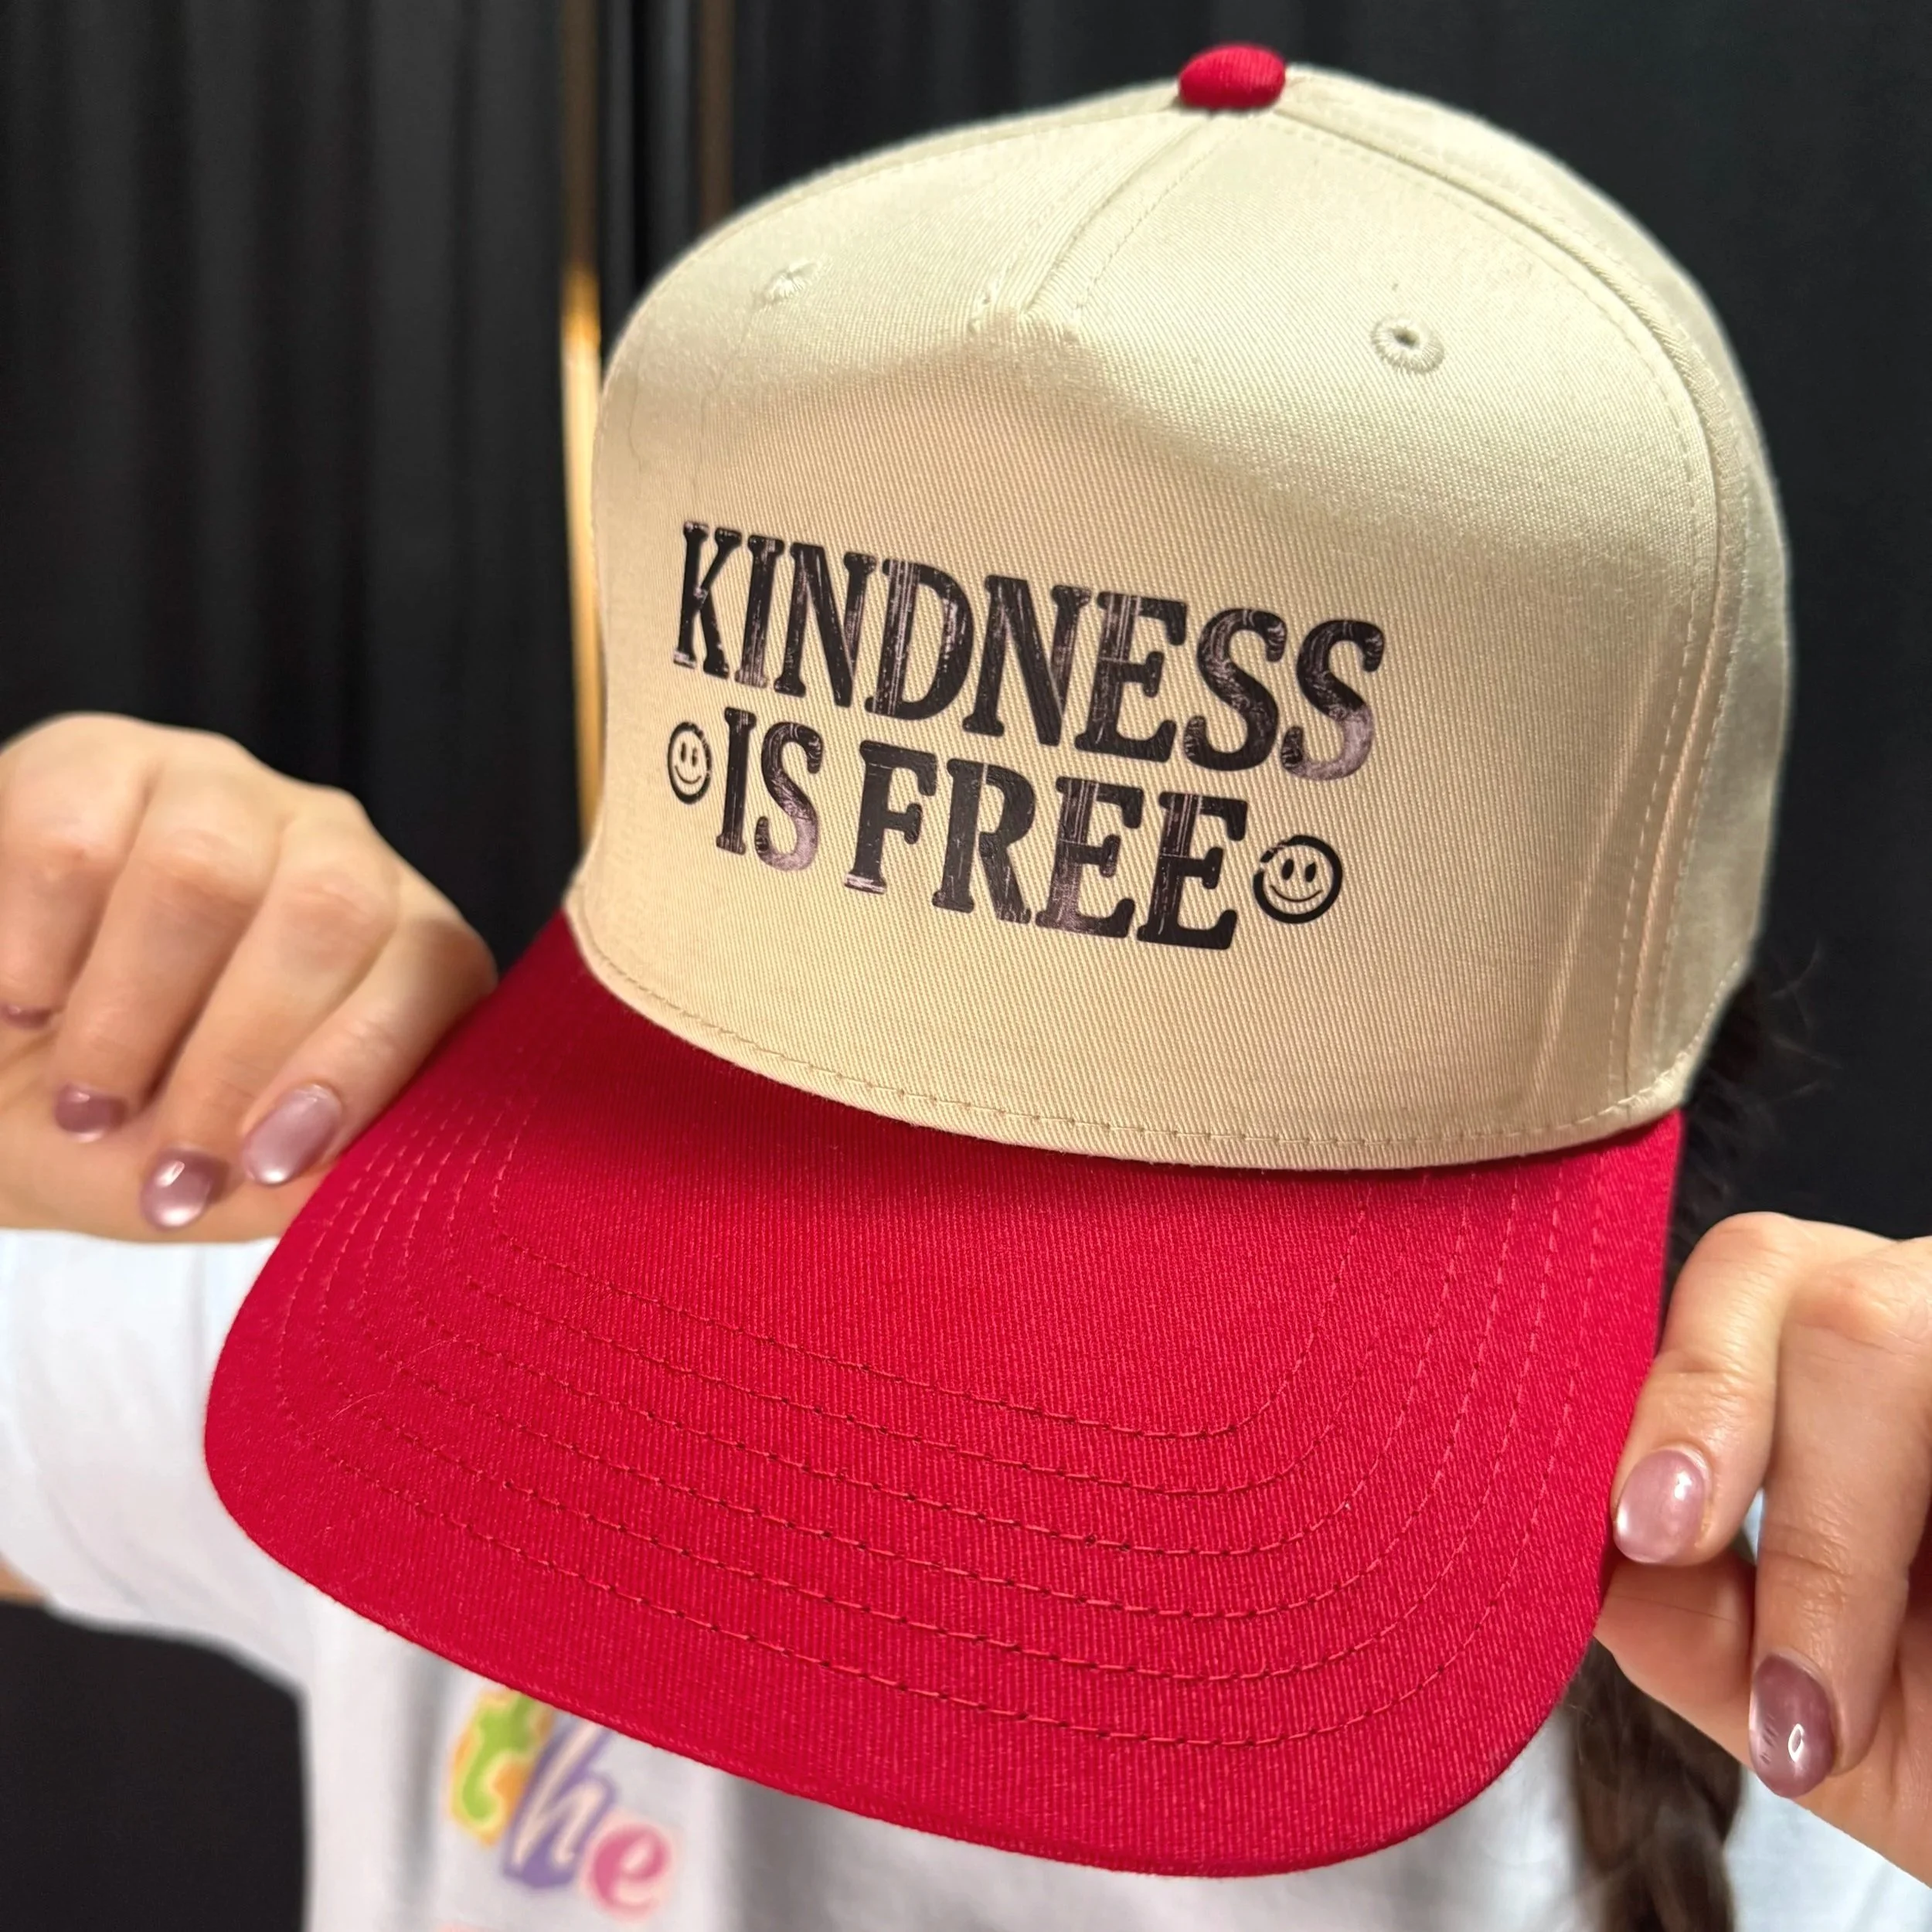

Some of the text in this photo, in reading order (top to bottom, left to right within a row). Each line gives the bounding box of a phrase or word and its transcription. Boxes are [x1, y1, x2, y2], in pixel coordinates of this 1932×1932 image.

[673, 520, 1387, 782] KINDNESS
[716, 706, 1250, 951] IS FREE
[448, 1689, 675, 1920] the
